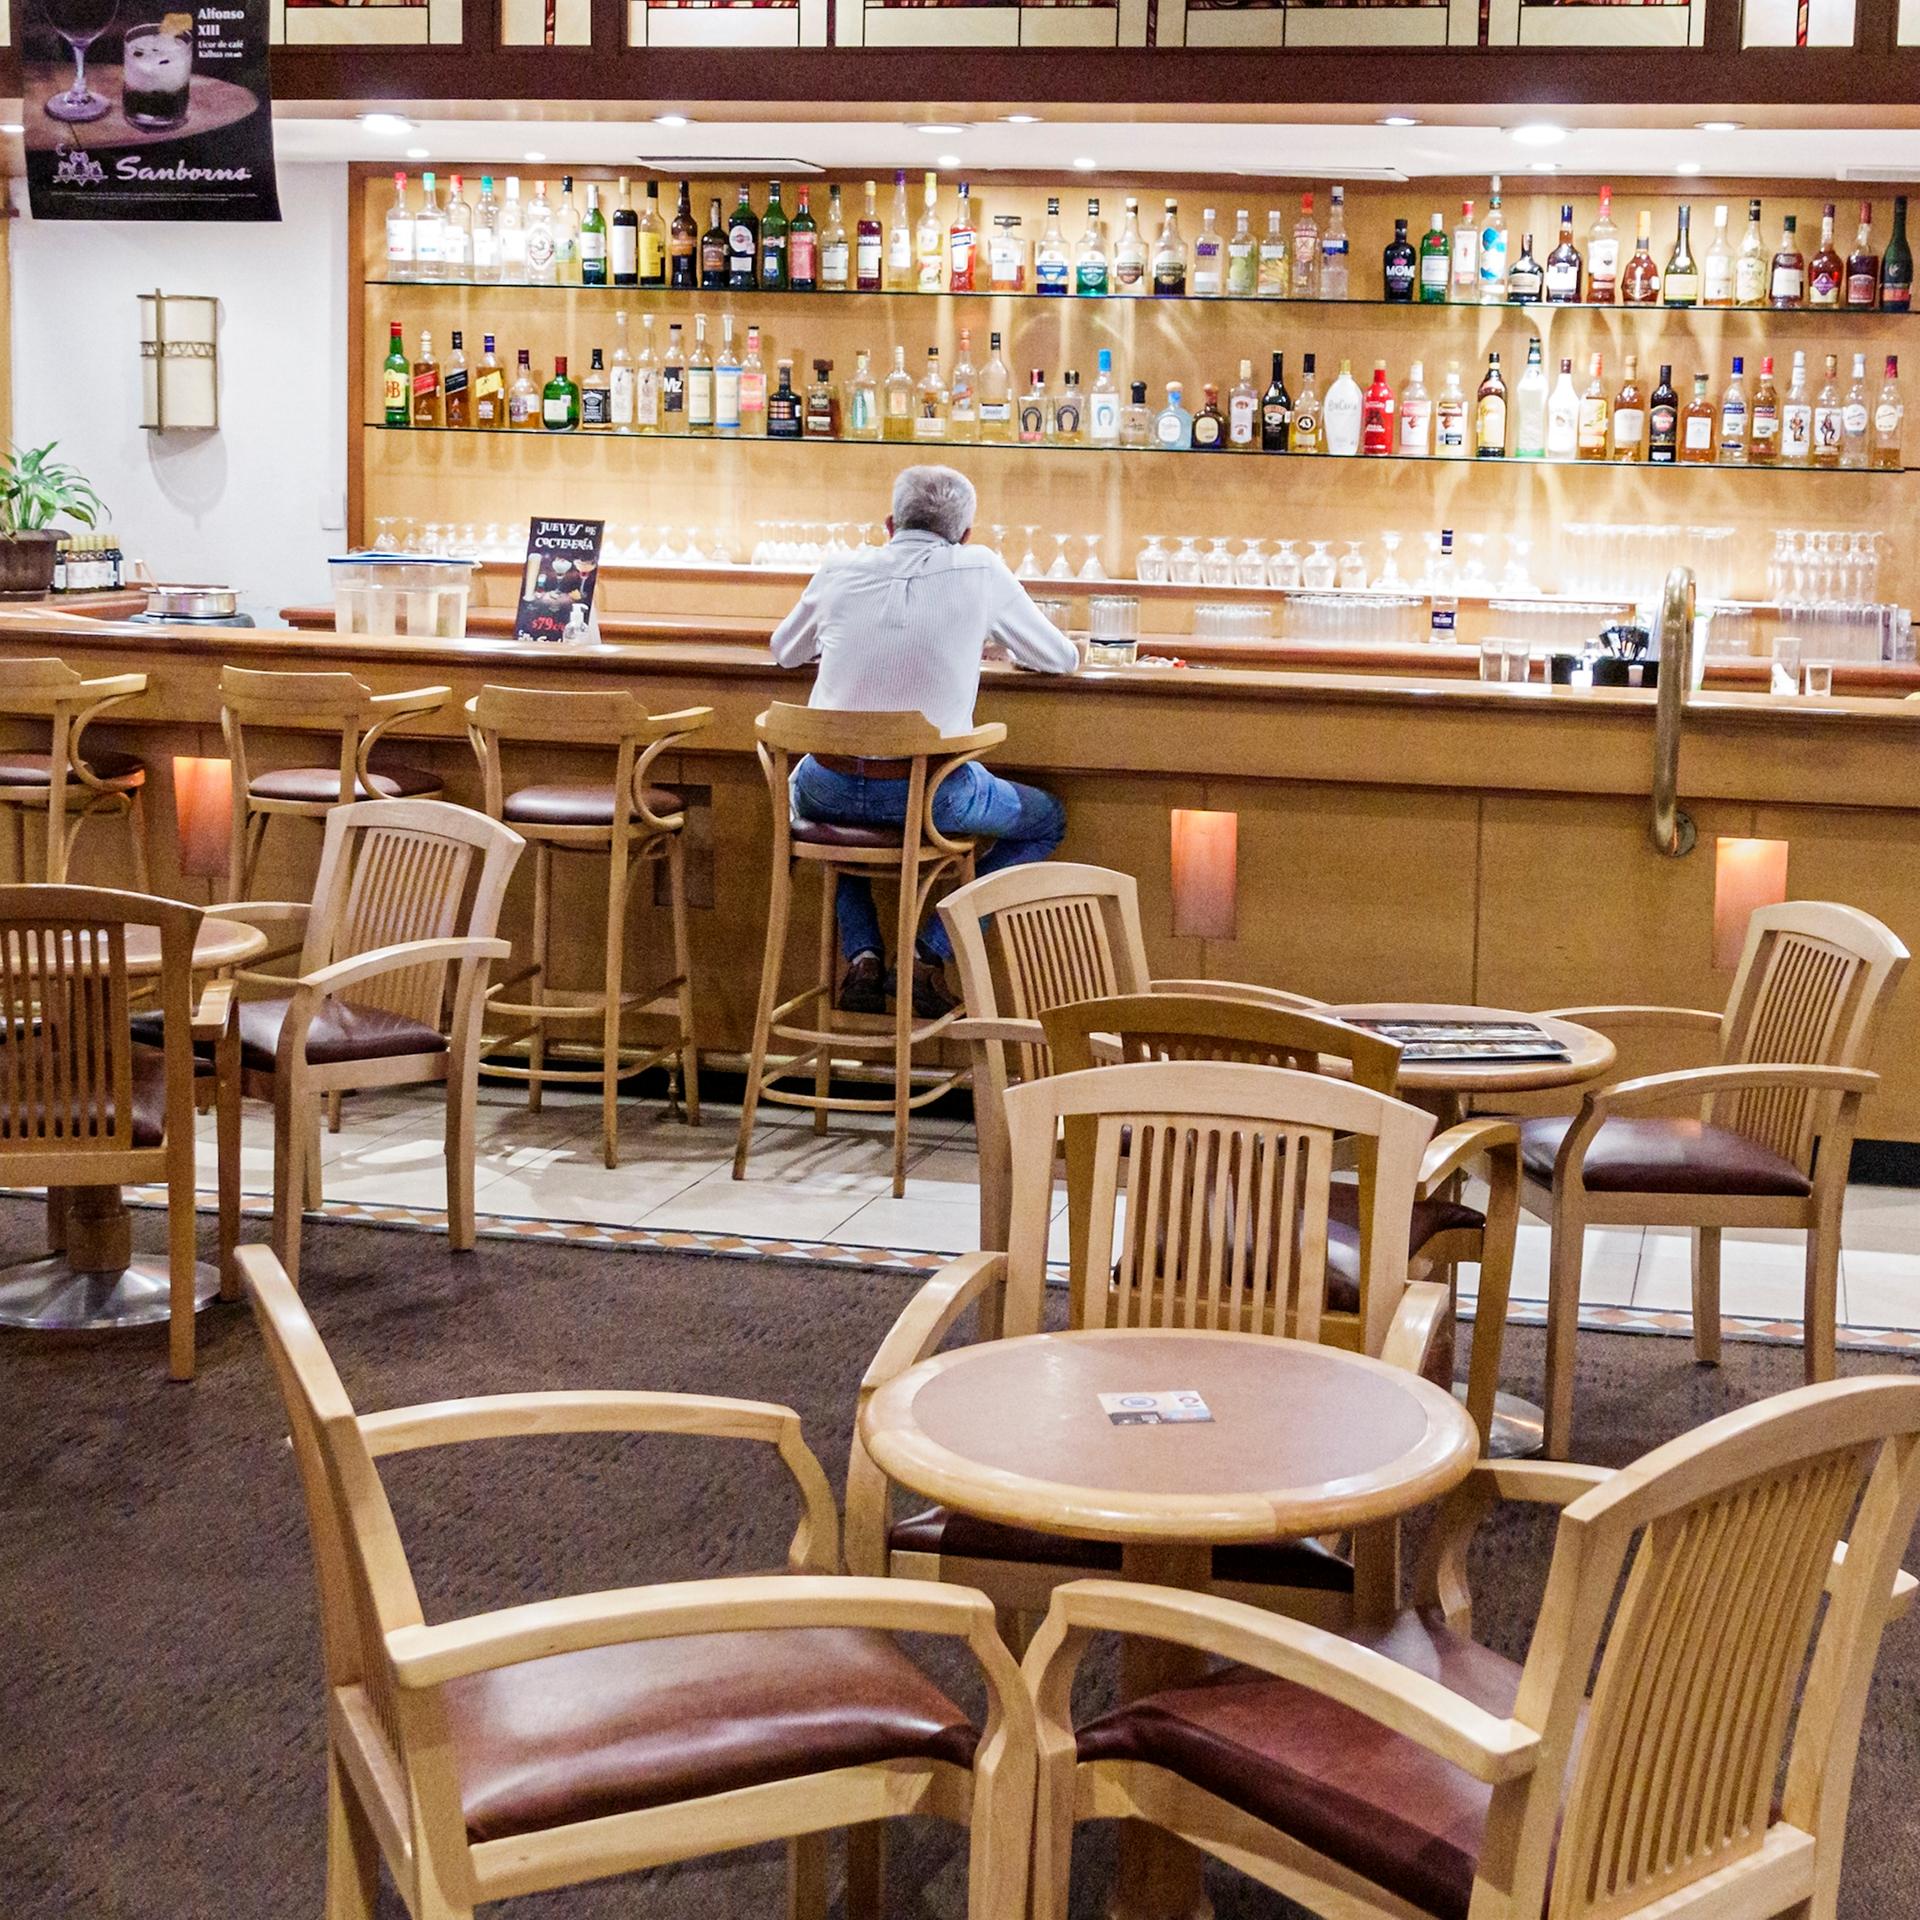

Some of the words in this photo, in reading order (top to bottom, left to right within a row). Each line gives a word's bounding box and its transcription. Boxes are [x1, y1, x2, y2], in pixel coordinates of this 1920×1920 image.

[198, 7, 245, 20] Alfonso
[198, 24, 220, 36] XIII
[198, 40, 216, 49] Licor
[217, 40, 227, 49] de
[116, 156, 252, 181] Sanborns
[537, 521, 584, 536] JUEVES
